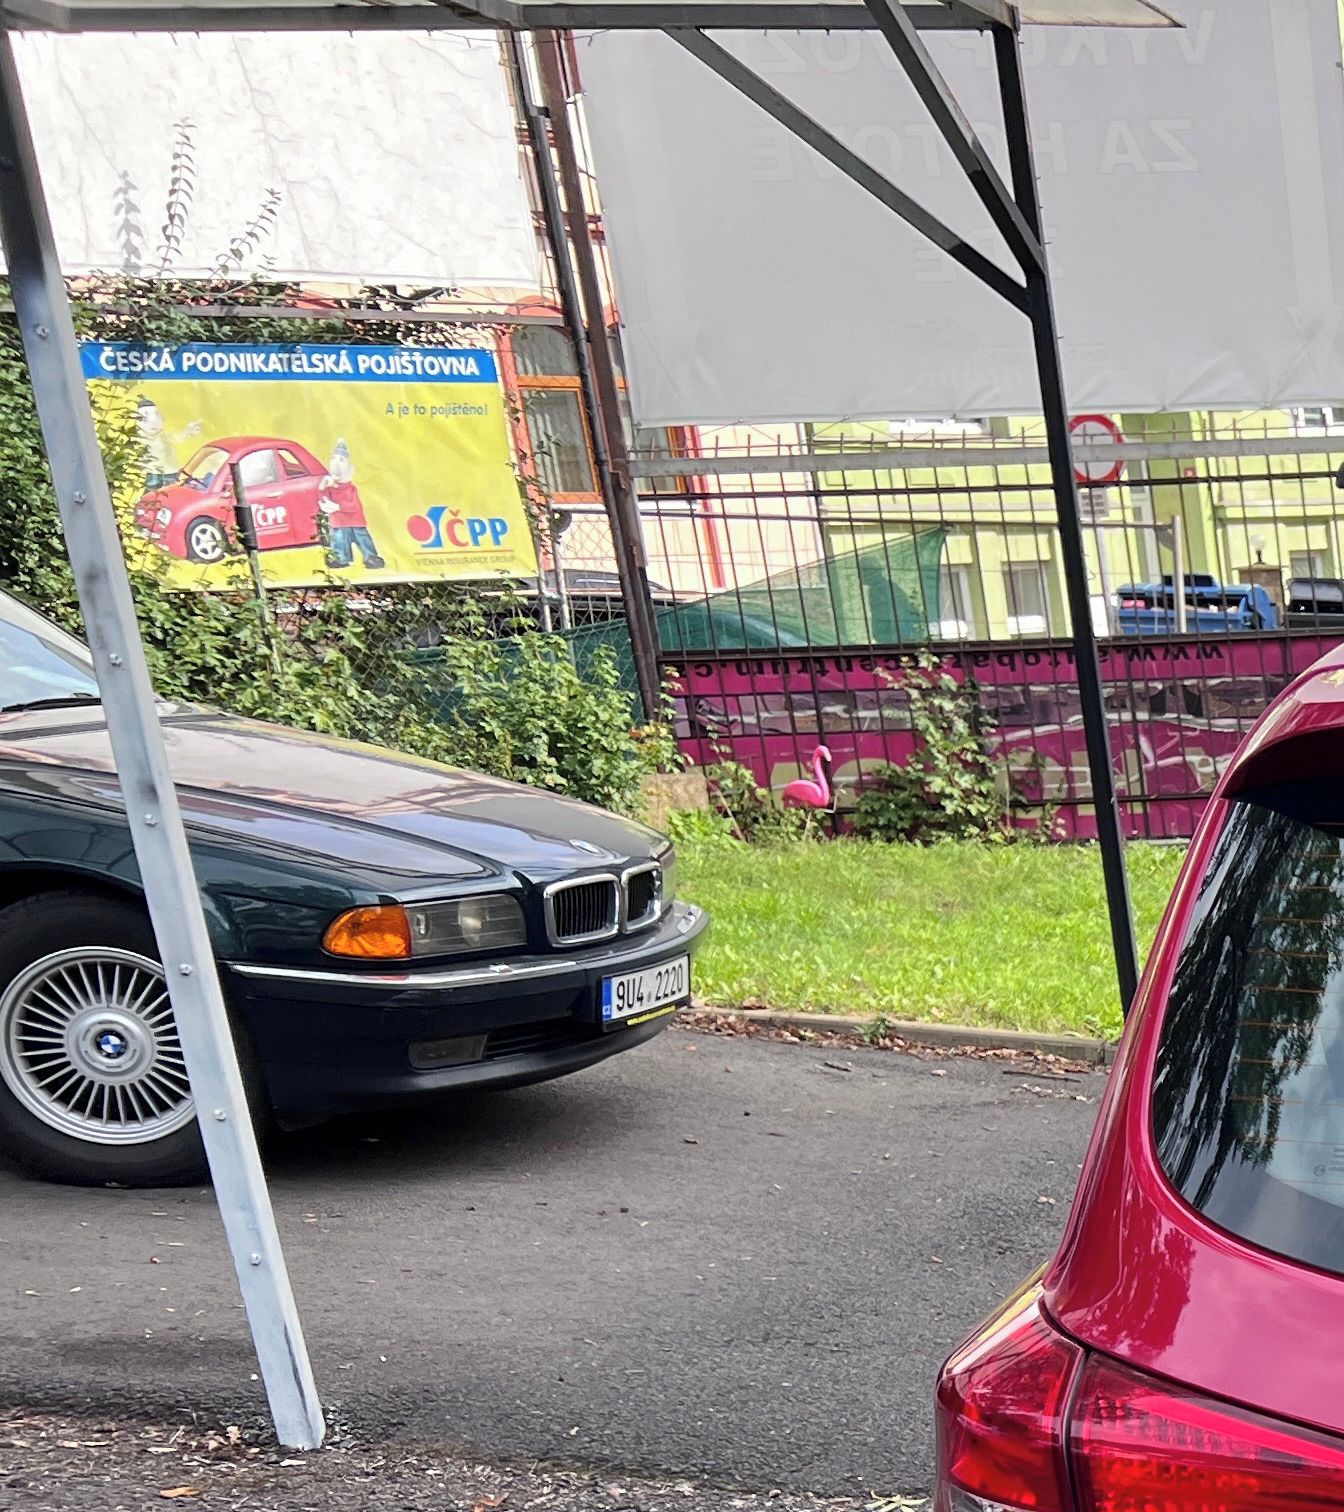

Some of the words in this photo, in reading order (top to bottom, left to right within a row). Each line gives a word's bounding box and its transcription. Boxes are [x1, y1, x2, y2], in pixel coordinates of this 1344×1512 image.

[100, 346, 175, 373] ČESKÁ
[182, 349, 353, 374] PODNIKATELSKÁ
[358, 351, 480, 376] POJIŠŤOVNA
[385, 402, 395, 415] A
[398, 401, 409, 418] je
[414, 403, 426, 415] to
[446, 508, 509, 547] ČPP
[616, 976, 644, 1011] 9U4
[655, 963, 684, 1001] 2220
